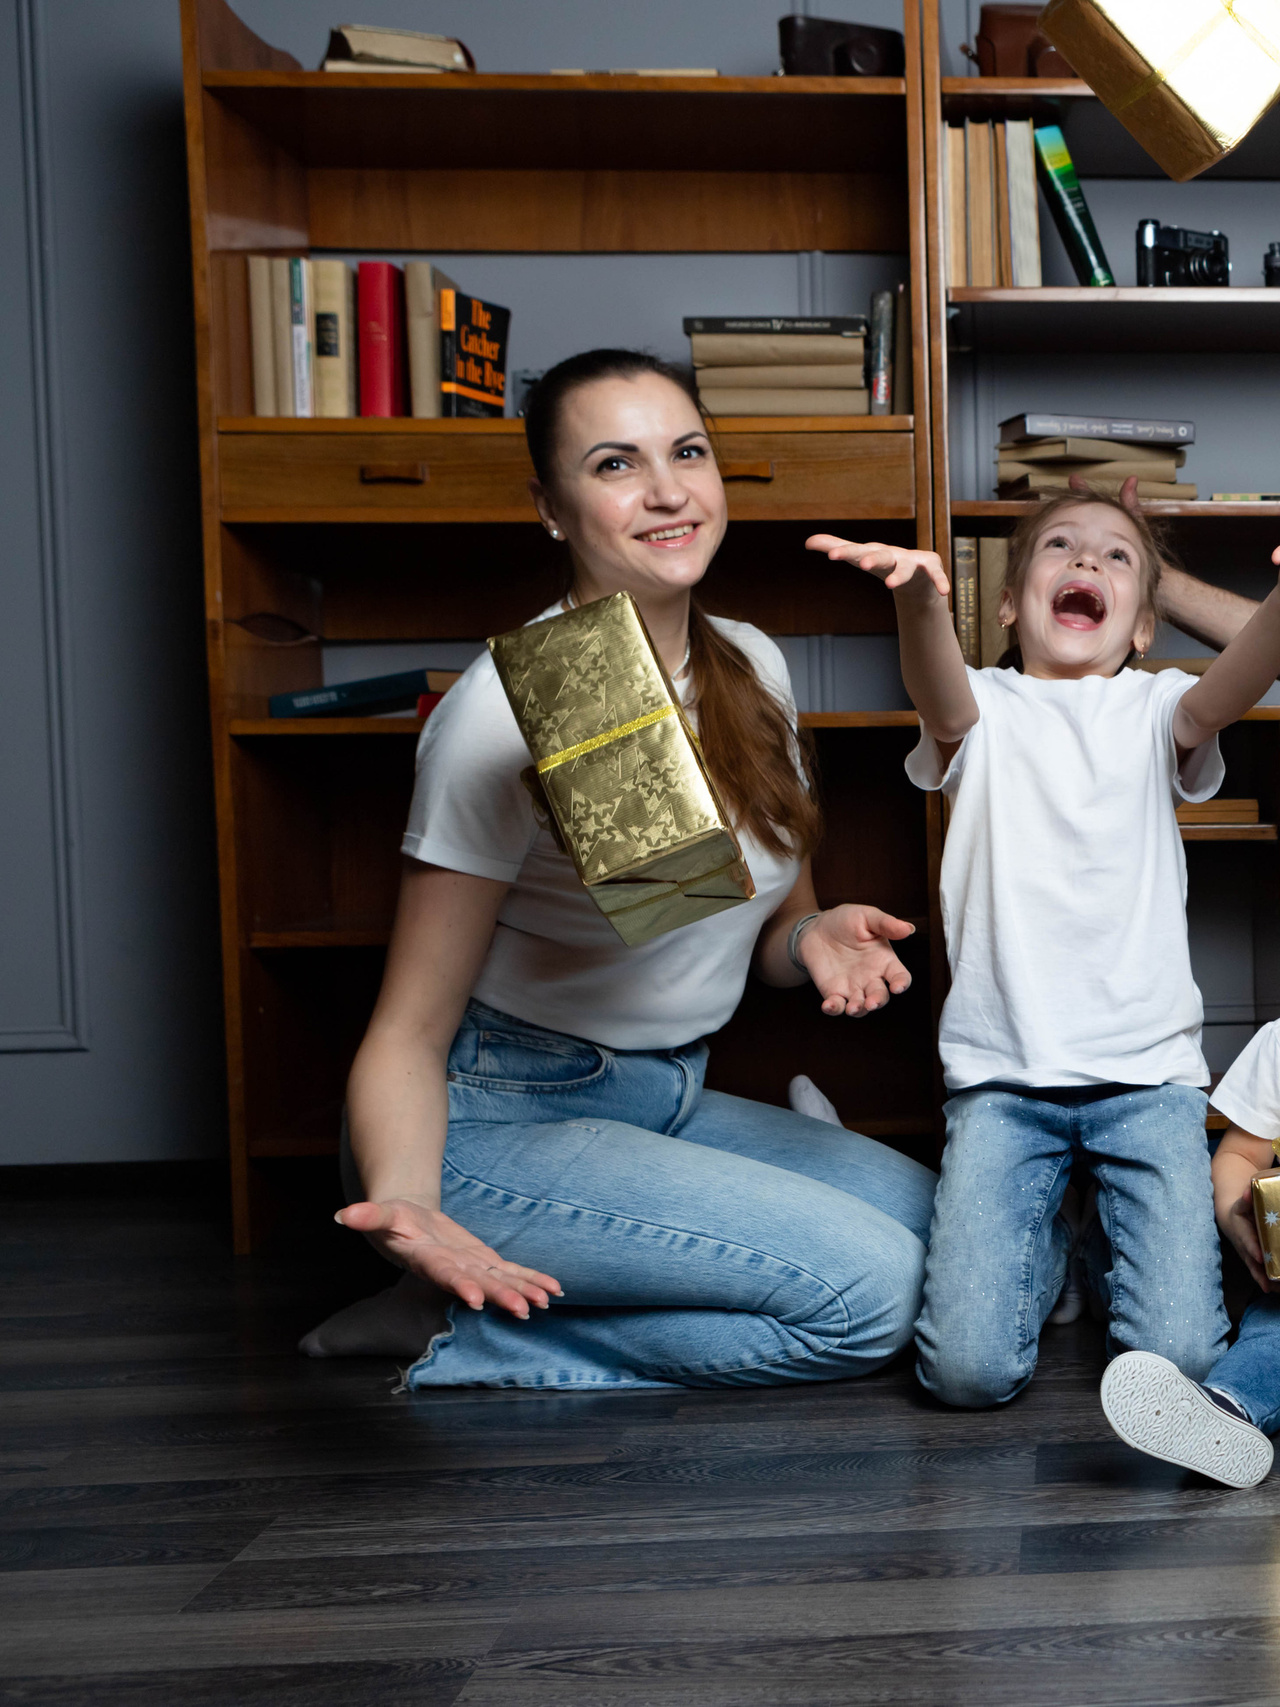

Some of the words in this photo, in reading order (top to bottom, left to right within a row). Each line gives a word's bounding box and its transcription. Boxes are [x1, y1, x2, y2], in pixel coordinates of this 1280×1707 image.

[471, 298, 492, 330] The
[460, 324, 500, 361] Catcher
[456, 353, 465, 380] in
[466, 356, 482, 385] the
[484, 360, 505, 394] Rye
